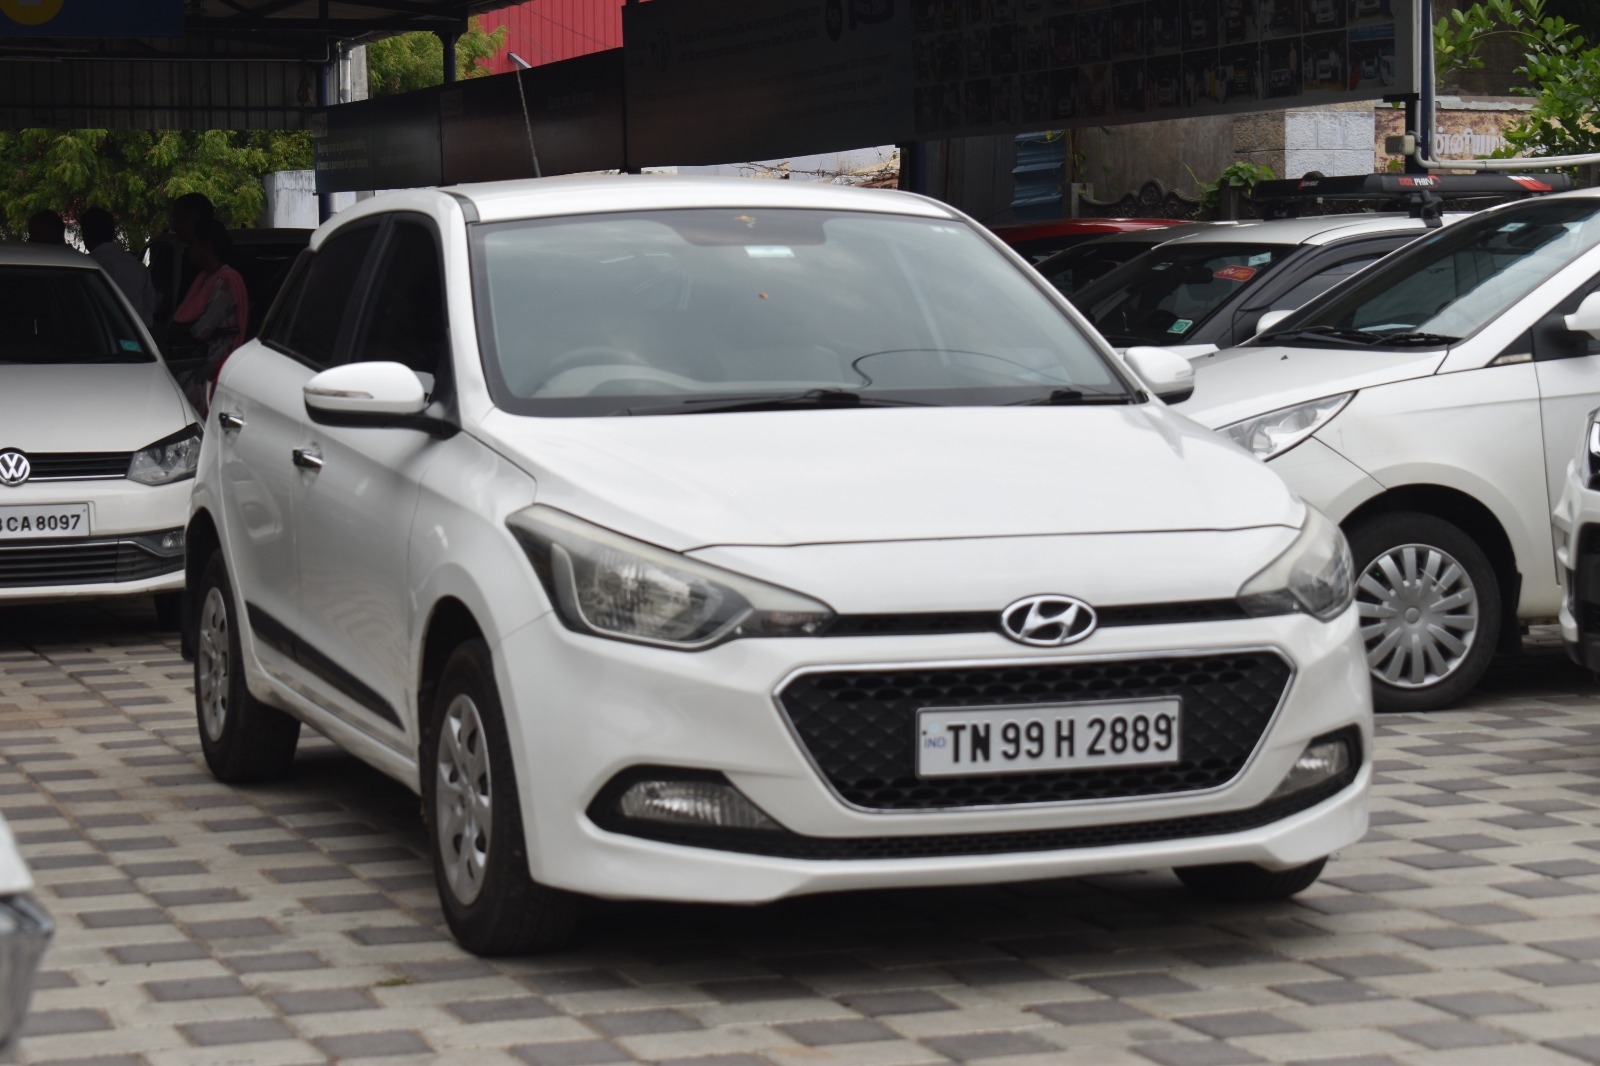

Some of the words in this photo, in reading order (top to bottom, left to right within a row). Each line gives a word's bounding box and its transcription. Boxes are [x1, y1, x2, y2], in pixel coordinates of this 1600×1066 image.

[36, 514, 81, 531] 8097
[923, 737, 946, 749] IND
[947, 723, 991, 763] TN
[1000, 720, 1044, 760] 99
[1055, 719, 1075, 758] H
[1087, 713, 1172, 755] 2889
